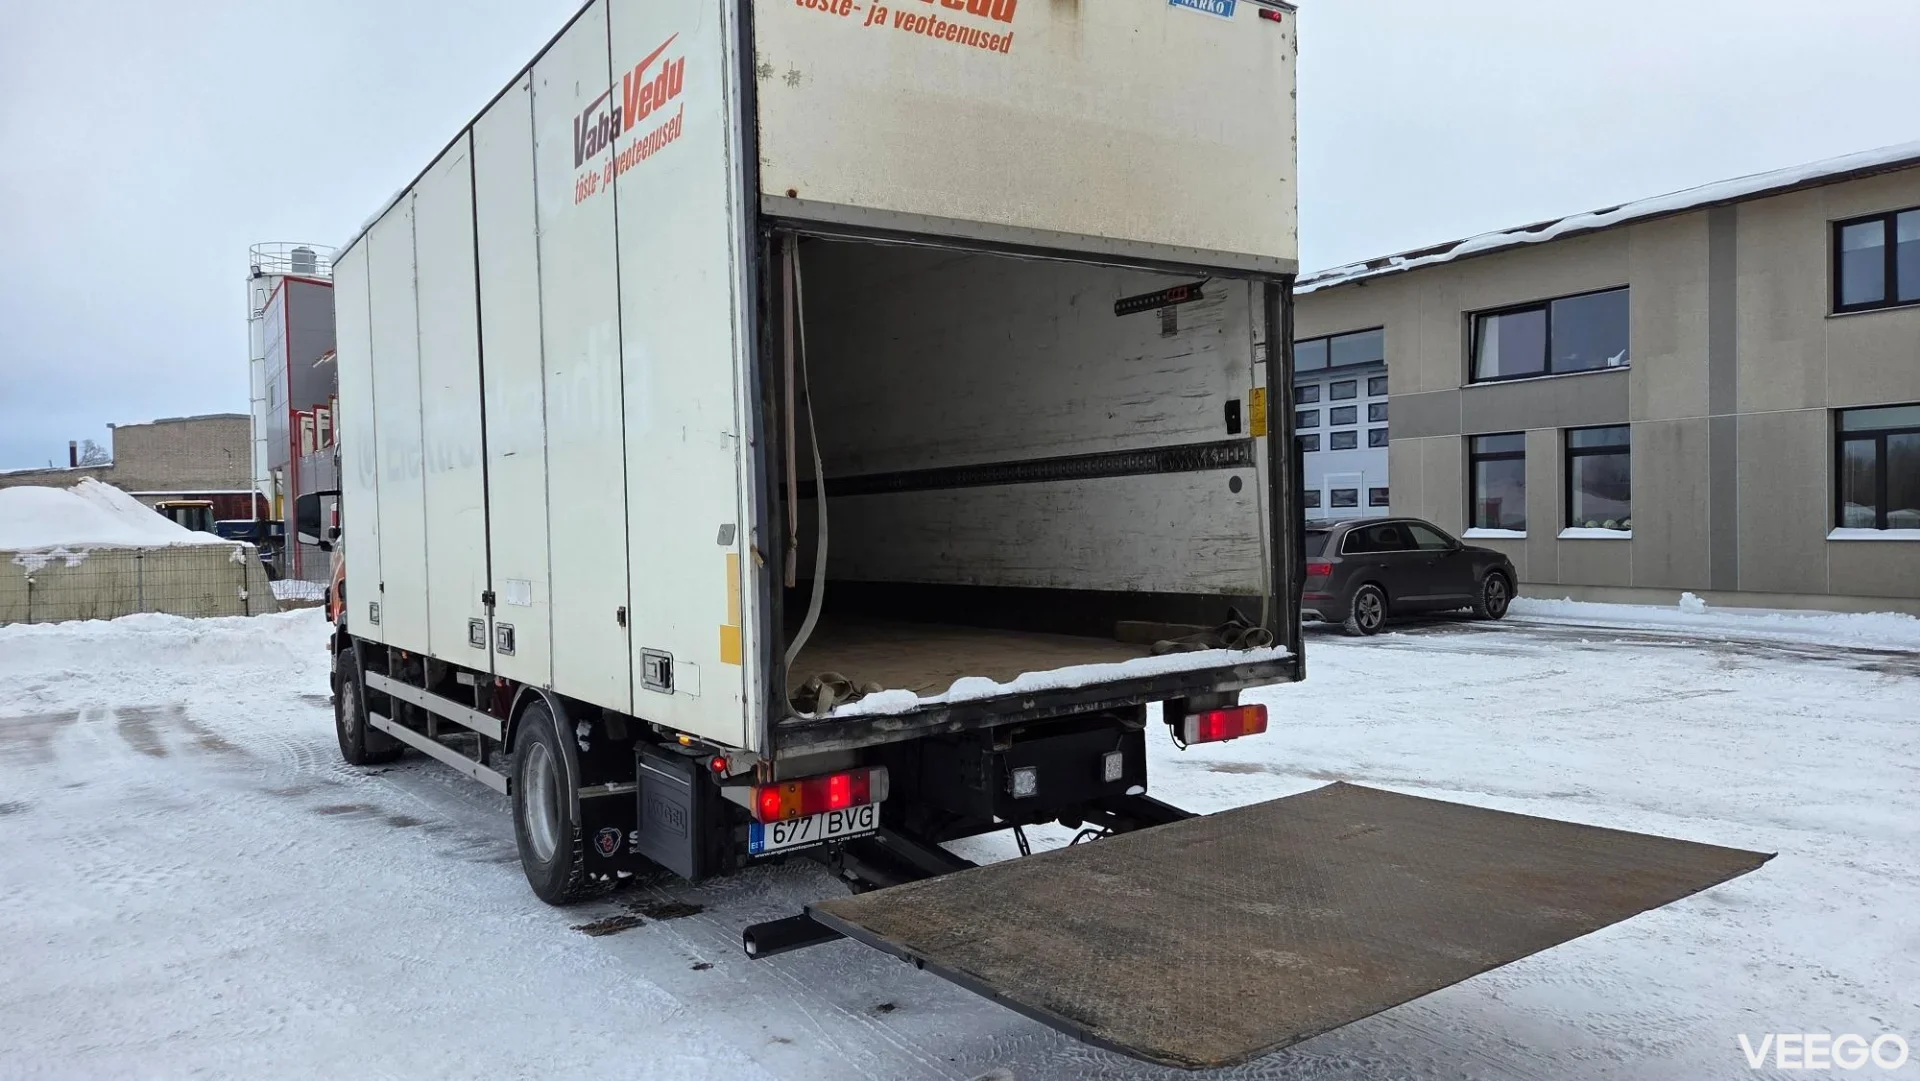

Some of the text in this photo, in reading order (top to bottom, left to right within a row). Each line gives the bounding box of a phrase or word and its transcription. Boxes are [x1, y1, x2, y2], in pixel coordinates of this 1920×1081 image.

[864, 0, 888, 27] ja
[893, 10, 1014, 54] veoteenused
[613, 102, 684, 179] veoteenused
[773, 815, 813, 844] 677
[828, 806, 874, 834] BVG
